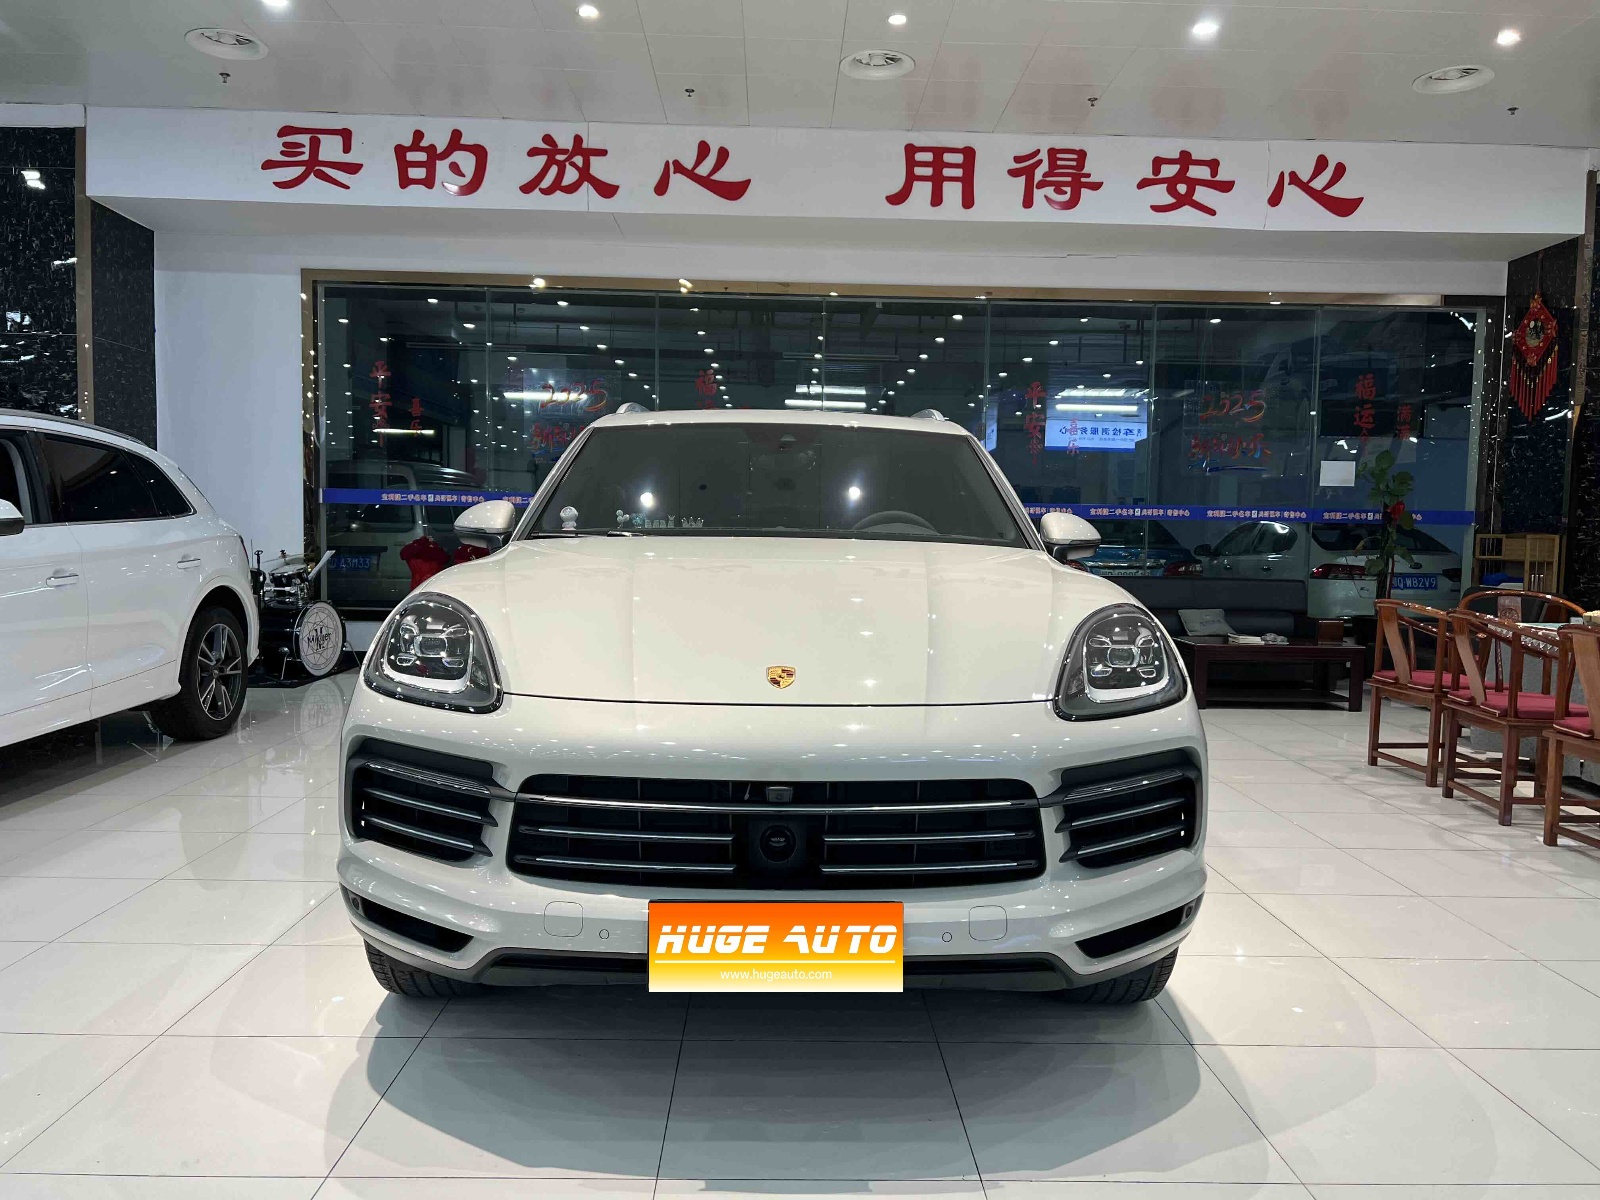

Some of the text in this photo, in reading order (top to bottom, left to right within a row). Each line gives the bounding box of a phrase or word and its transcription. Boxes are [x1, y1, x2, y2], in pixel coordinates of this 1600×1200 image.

[260, 125, 1365, 218] 买的放心 用得安心
[539, 378, 607, 412] 2025
[1024, 381, 1048, 439] 平安
[1353, 373, 1376, 429] 福运
